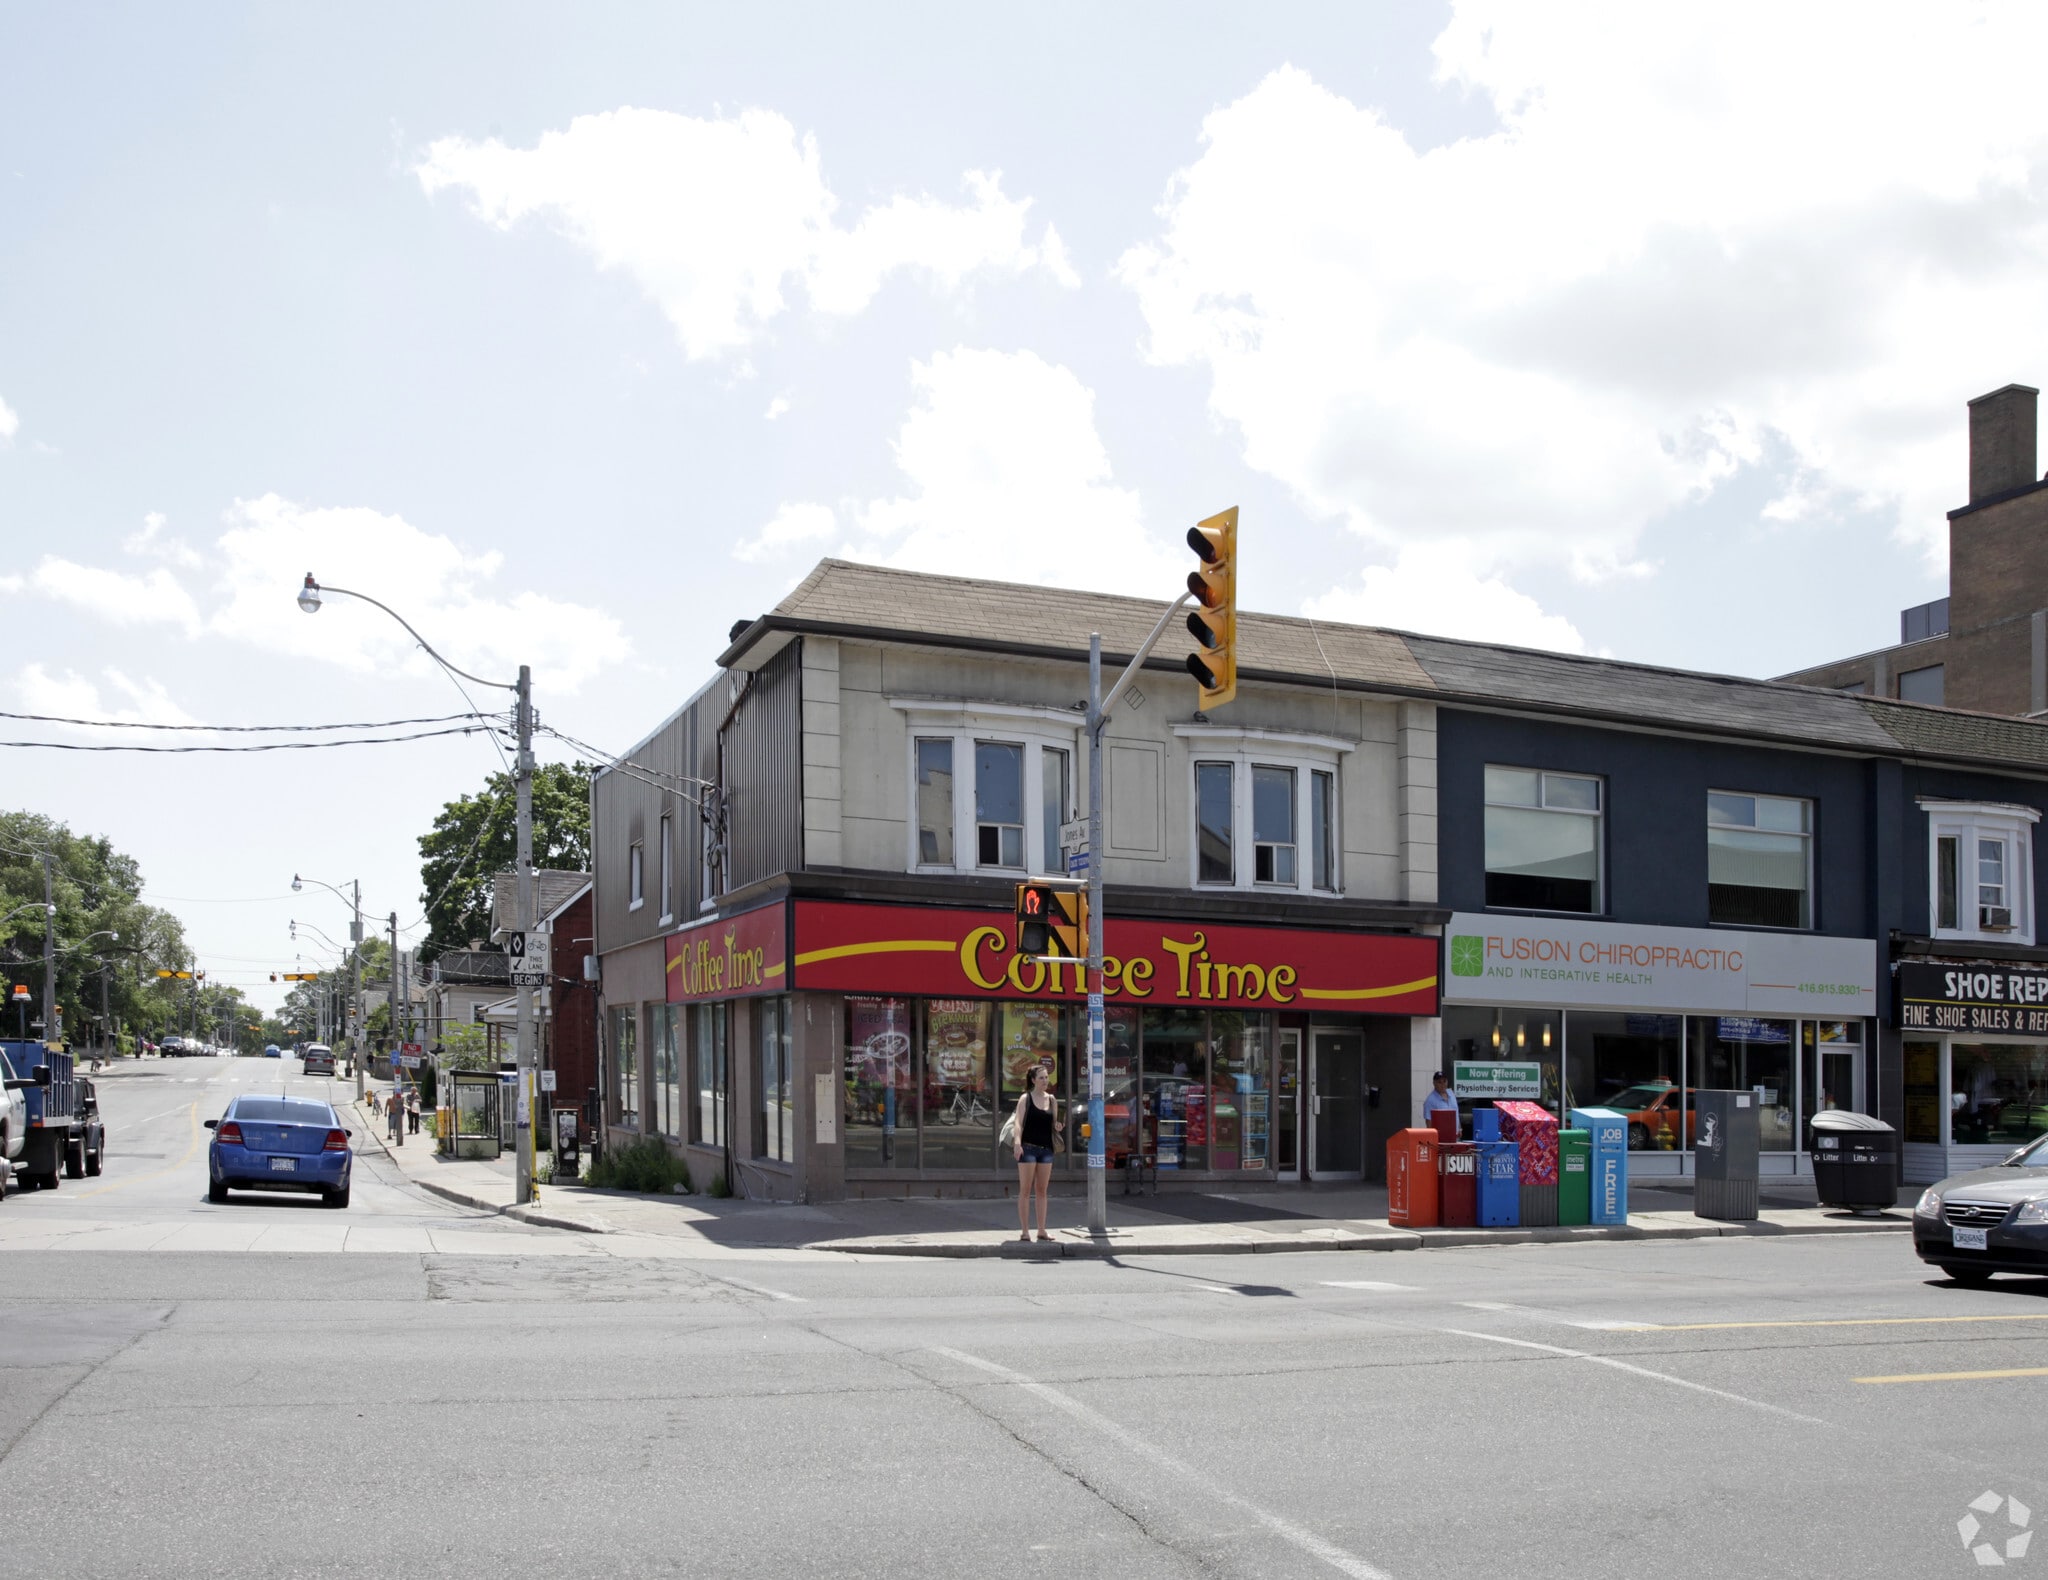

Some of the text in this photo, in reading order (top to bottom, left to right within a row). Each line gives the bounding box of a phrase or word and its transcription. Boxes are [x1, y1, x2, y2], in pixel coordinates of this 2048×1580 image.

[682, 924, 763, 996] Coffee Time
[1487, 936, 1743, 972] FUSION CHIROPRACTIC
[1162, 931, 1298, 1003] Time
[1487, 966, 1653, 985] AND INTEGRATIVE HEALTH
[513, 974, 543, 985] BEGINS
[1945, 971, 2048, 1004] SHOE REP
[1904, 1005, 1931, 1027] FINE
[1936, 1007, 1967, 1028] SHOE
[1972, 1008, 2010, 1029] SALES
[2014, 1010, 2024, 1030] &
[1469, 1068, 1526, 1081] Now Offering
[1509, 1085, 1539, 1094] Services
[1601, 1128, 1623, 1141] JOB
[1449, 1156, 1473, 1173] SUN
[1823, 1153, 1839, 1161] Litter
[1488, 1163, 1514, 1173] STAR
[1605, 1159, 1617, 1216] FREE
